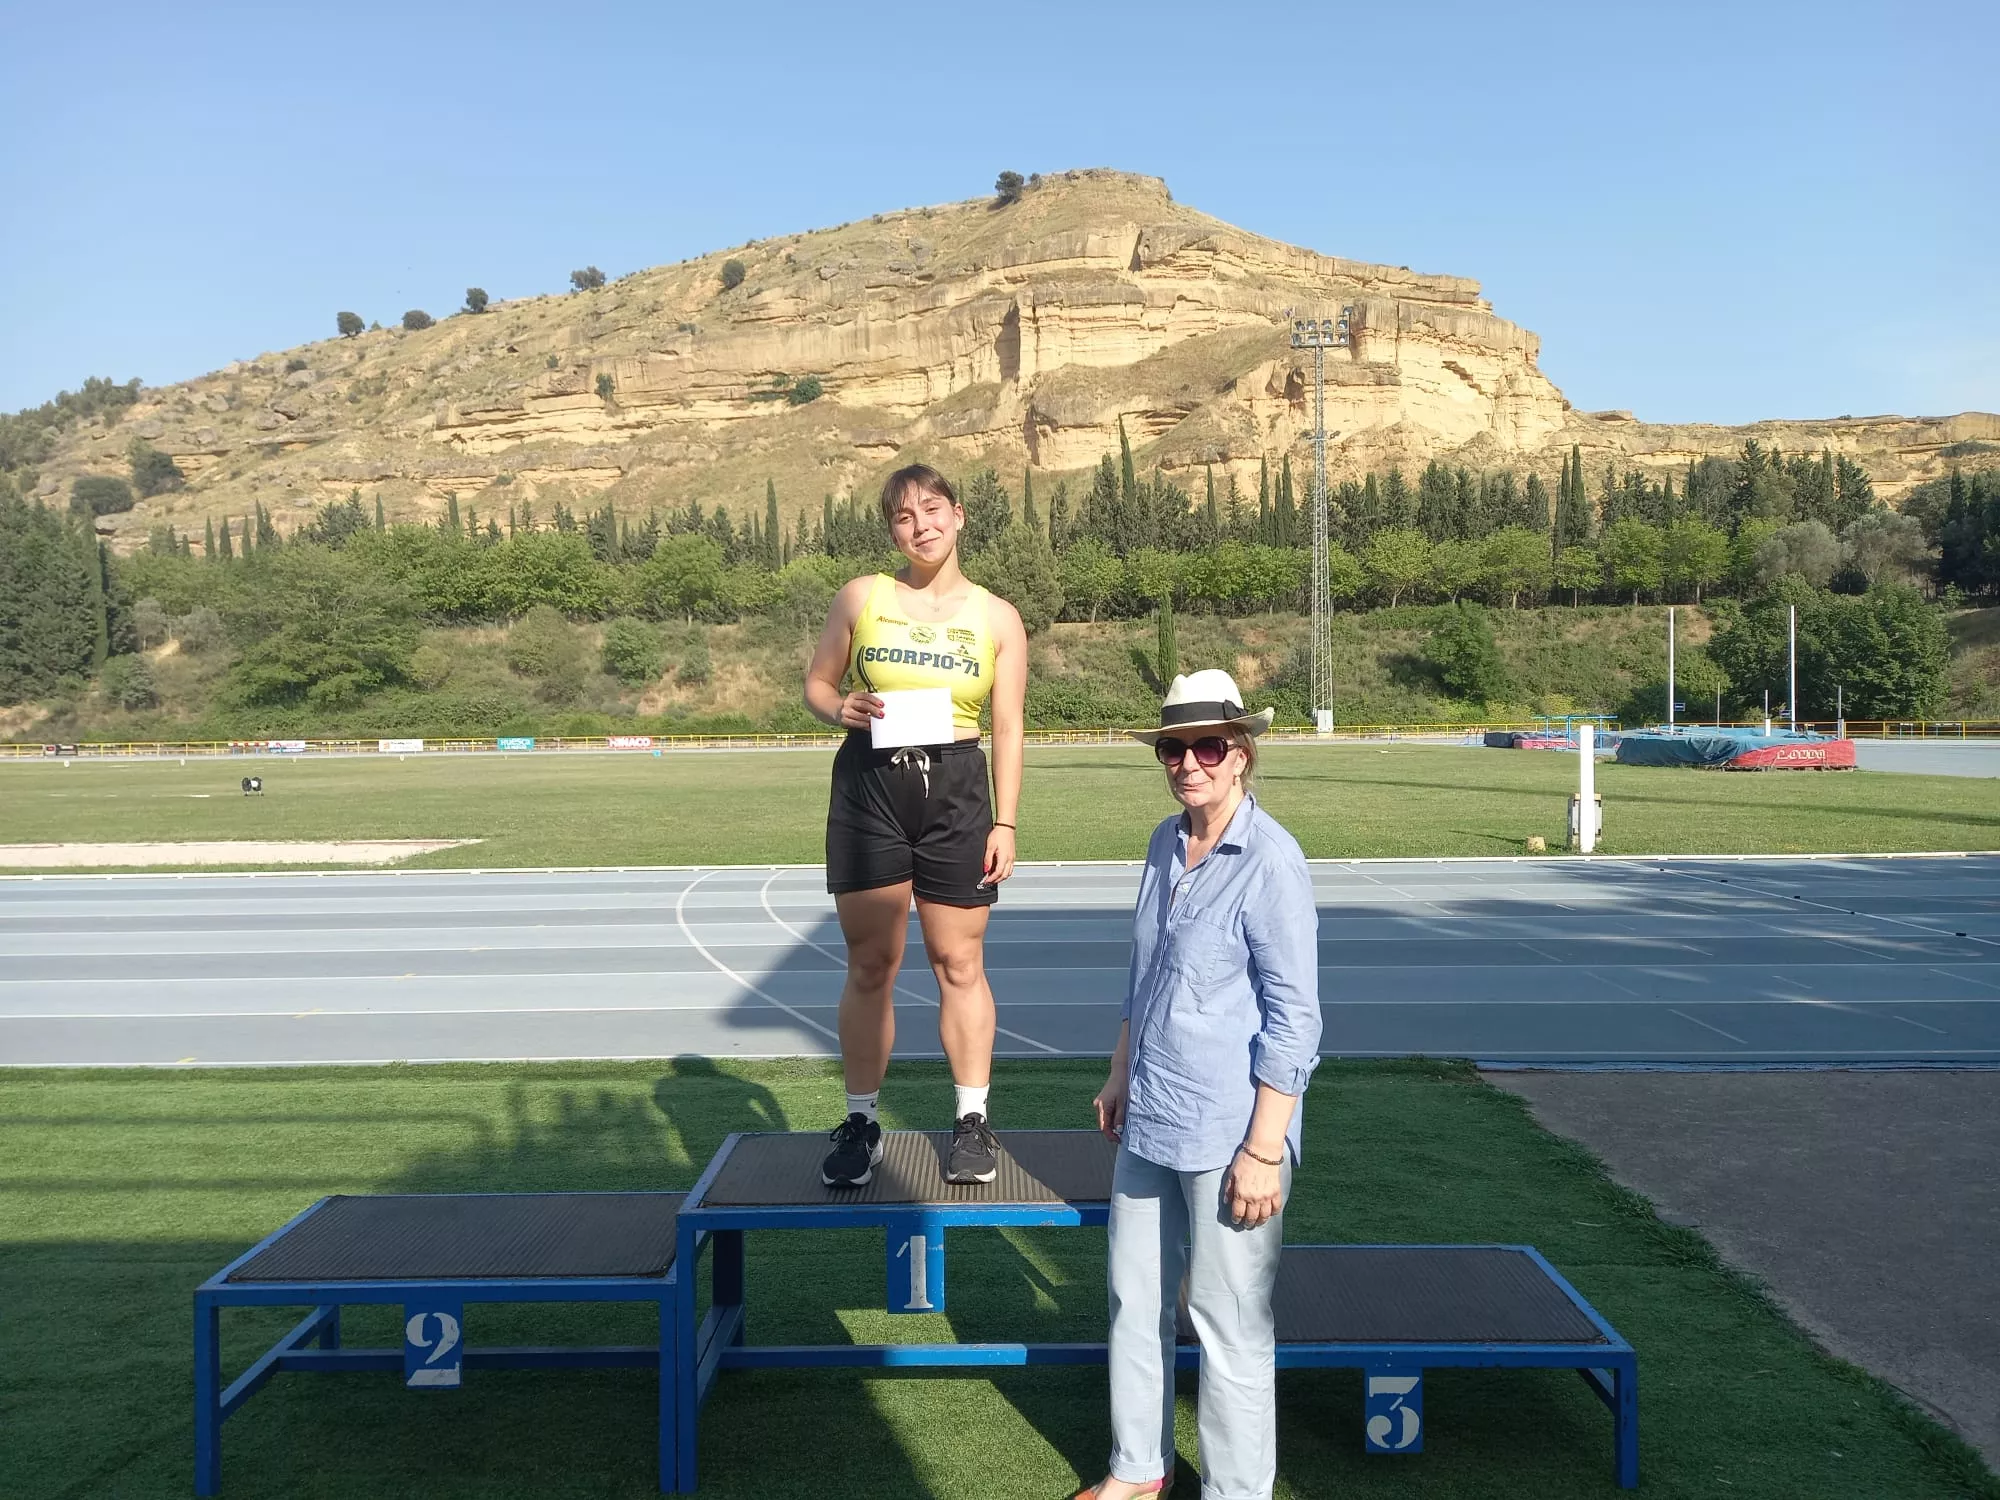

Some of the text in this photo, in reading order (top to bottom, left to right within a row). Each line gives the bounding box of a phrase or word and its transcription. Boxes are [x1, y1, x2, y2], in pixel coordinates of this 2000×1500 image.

[864, 647, 980, 677] SCORPIO-71
[896, 1235, 934, 1309] 1
[406, 1312, 460, 1386] 2
[1367, 1376, 1420, 1449] 3
